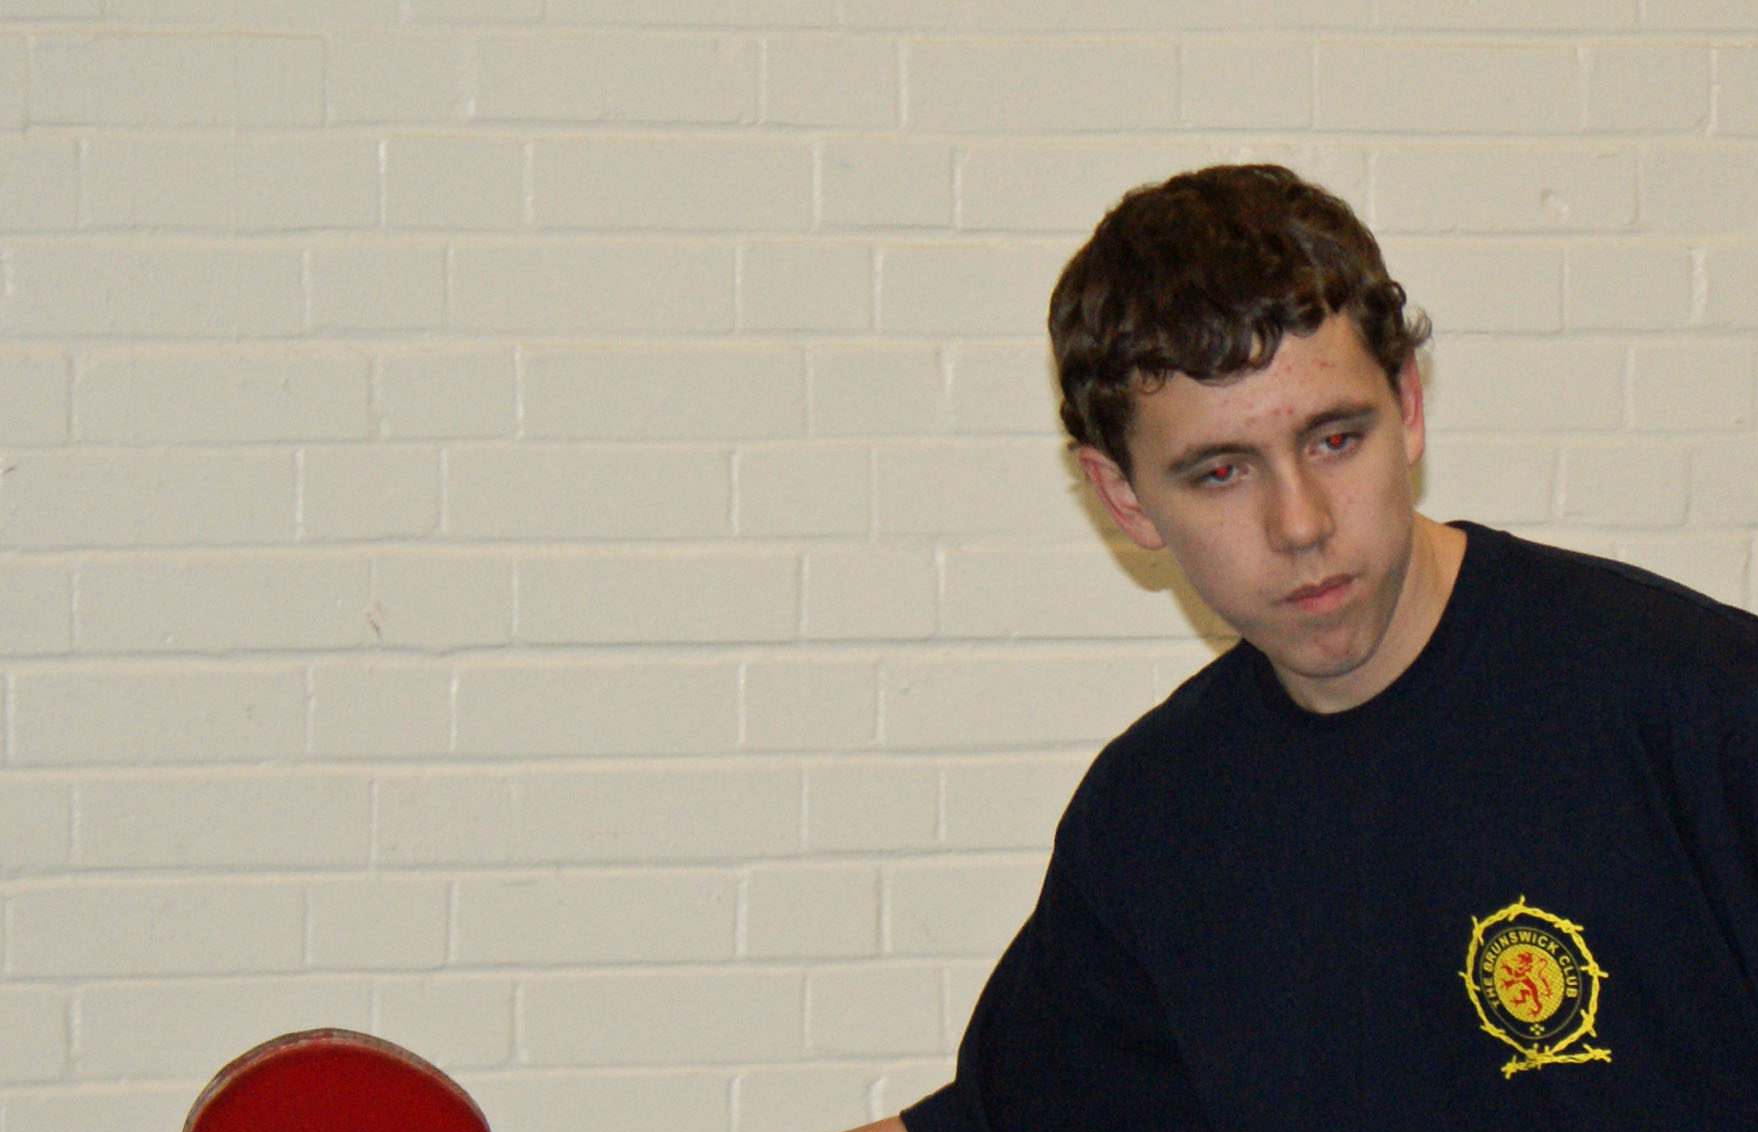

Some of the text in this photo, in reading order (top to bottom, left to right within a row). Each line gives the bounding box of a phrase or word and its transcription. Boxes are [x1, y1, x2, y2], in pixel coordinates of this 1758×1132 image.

[1483, 930, 1578, 1008] THE BRUNSWICK CLUB
